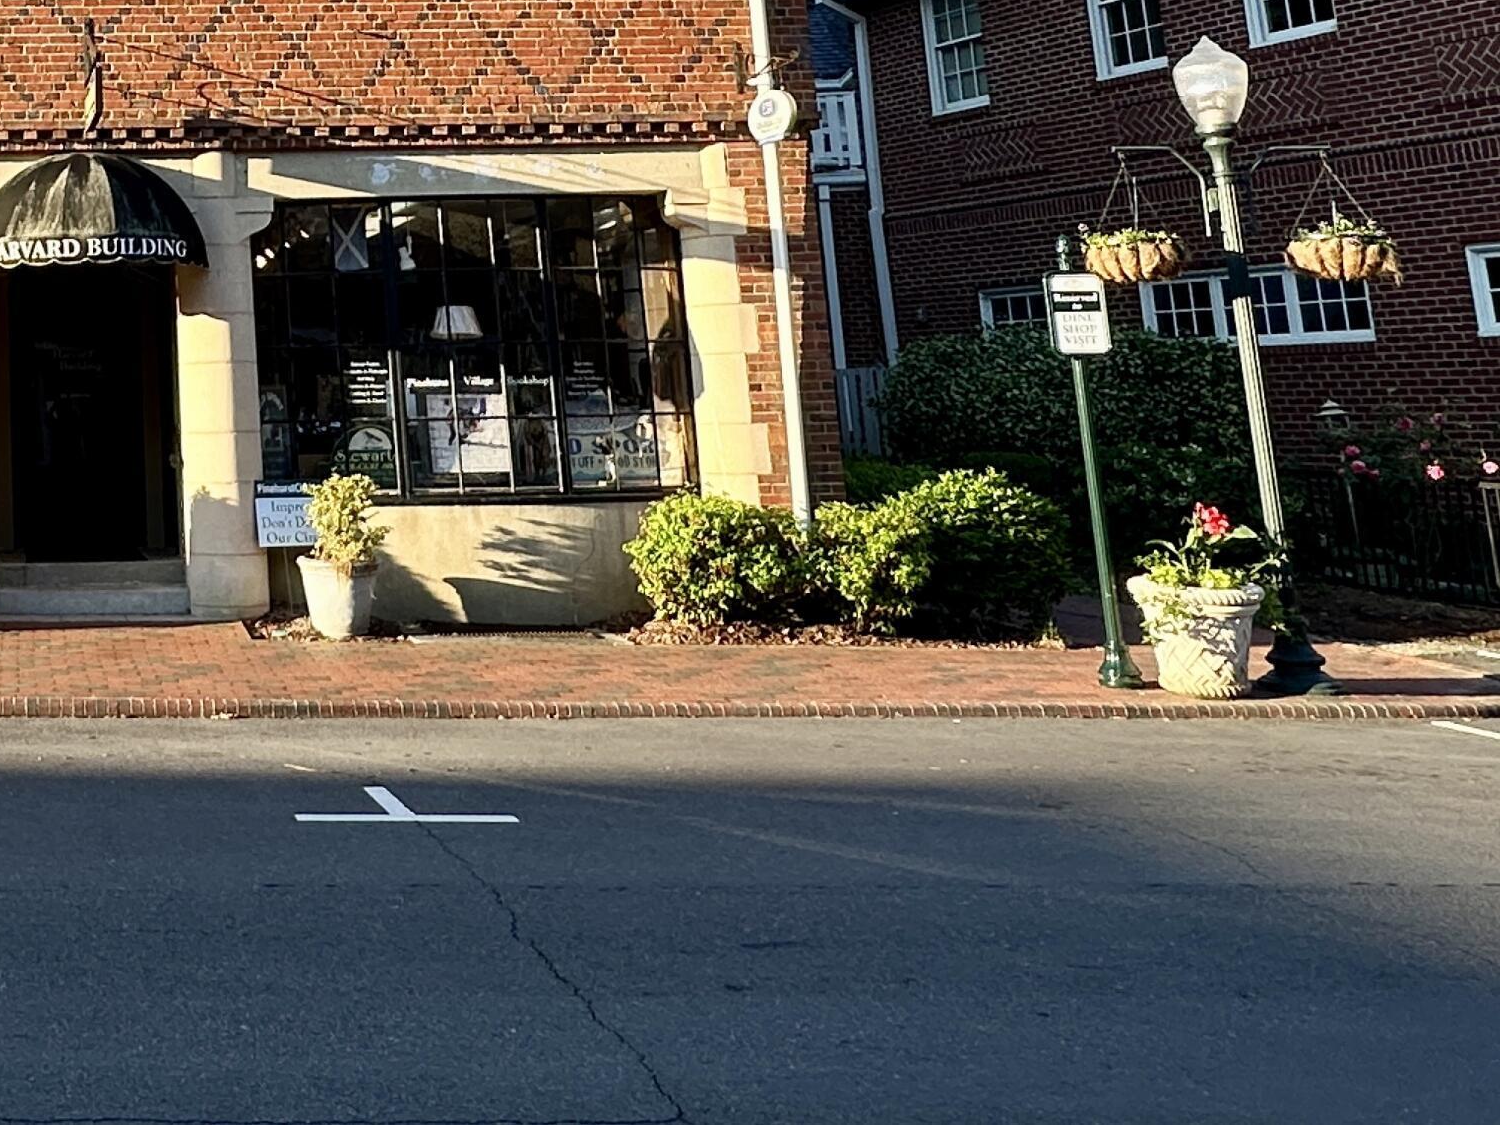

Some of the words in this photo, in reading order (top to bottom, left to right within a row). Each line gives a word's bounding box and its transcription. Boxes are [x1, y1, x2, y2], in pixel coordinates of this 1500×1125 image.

[87, 237, 188, 258] BUILDING
[1062, 314, 1092, 323] DINE
[1062, 324, 1098, 334] SHOP
[1064, 335, 1098, 345] VISIT
[463, 375, 494, 387] Village
[334, 449, 396, 463] Sewart
[262, 516, 292, 529] Don't
[267, 532, 291, 544] Our
